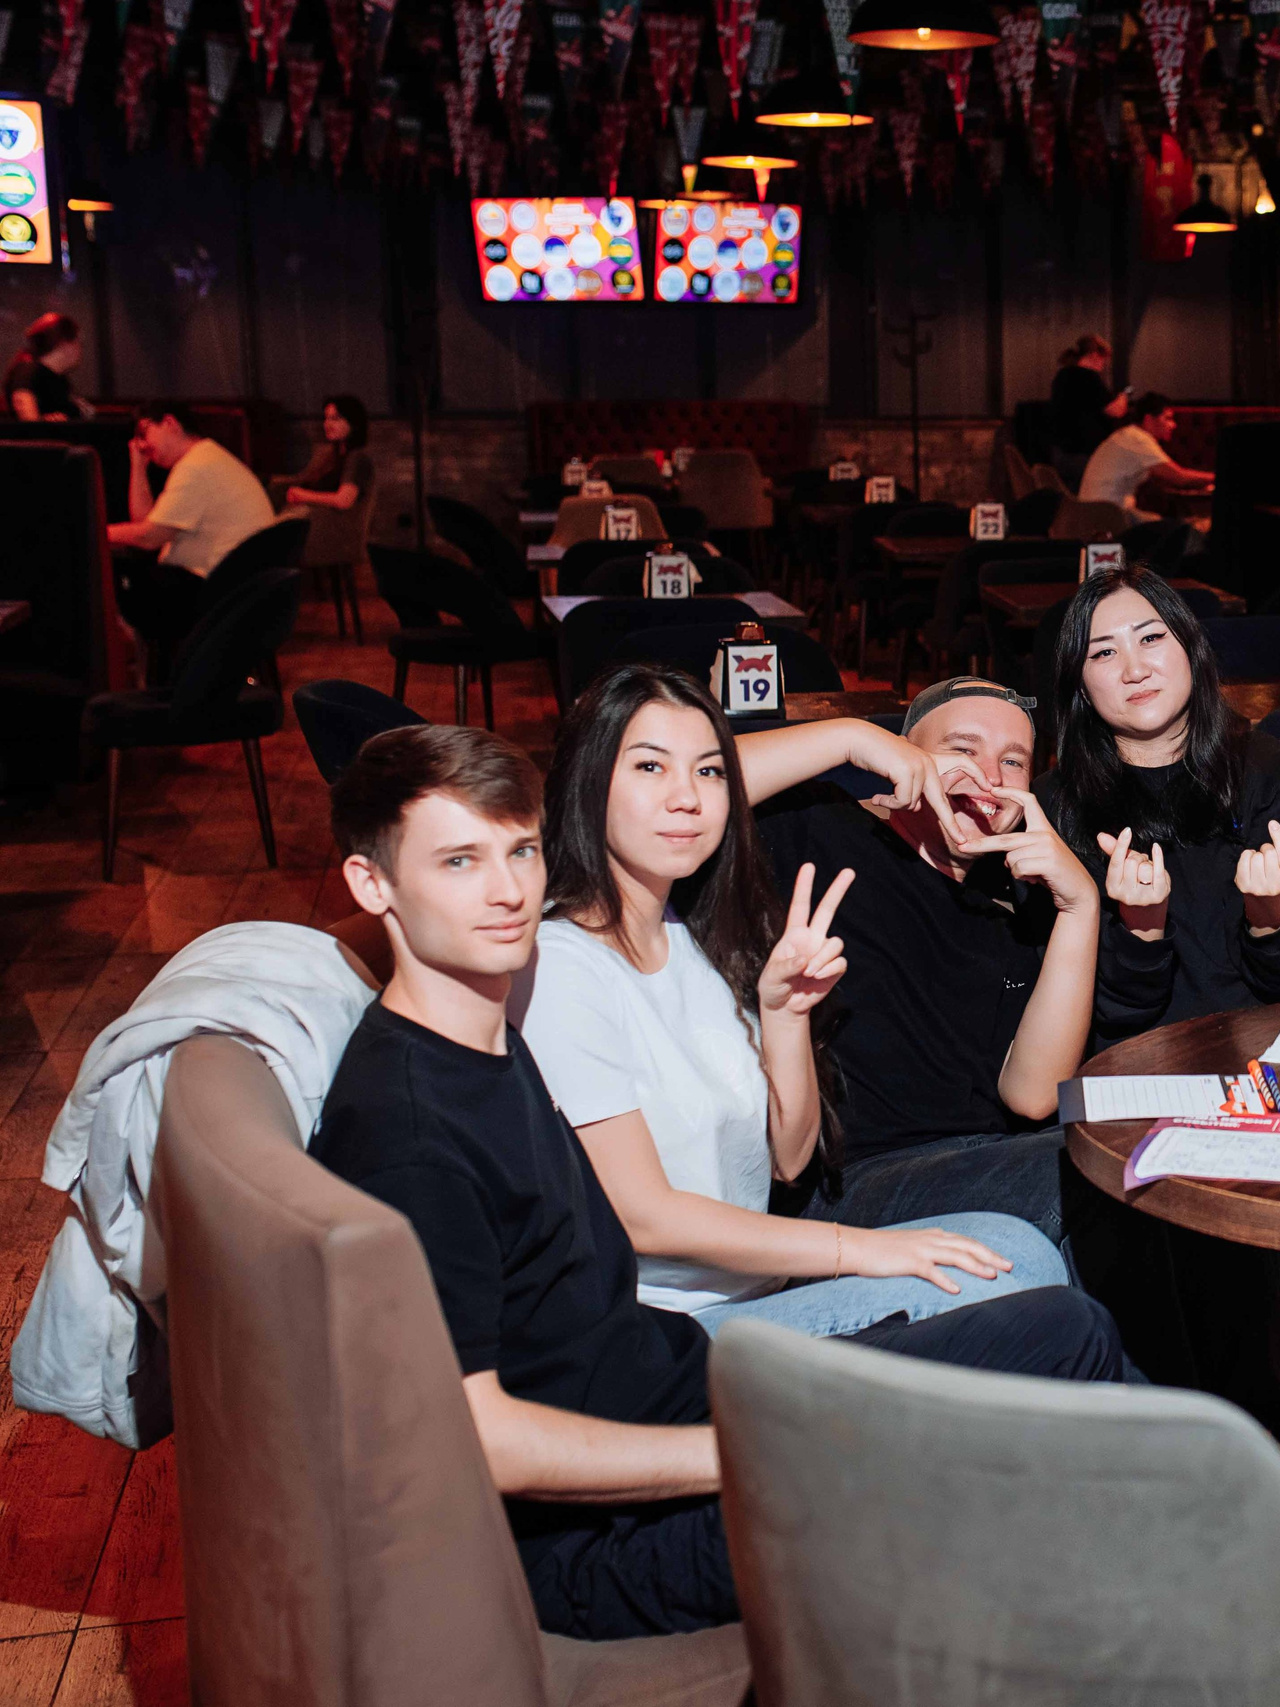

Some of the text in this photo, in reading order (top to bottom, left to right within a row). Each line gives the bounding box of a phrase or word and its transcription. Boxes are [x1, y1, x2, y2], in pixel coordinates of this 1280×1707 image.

[982, 522, 1000, 535] 22
[660, 579, 682, 596] 18
[739, 678, 771, 702] 19
